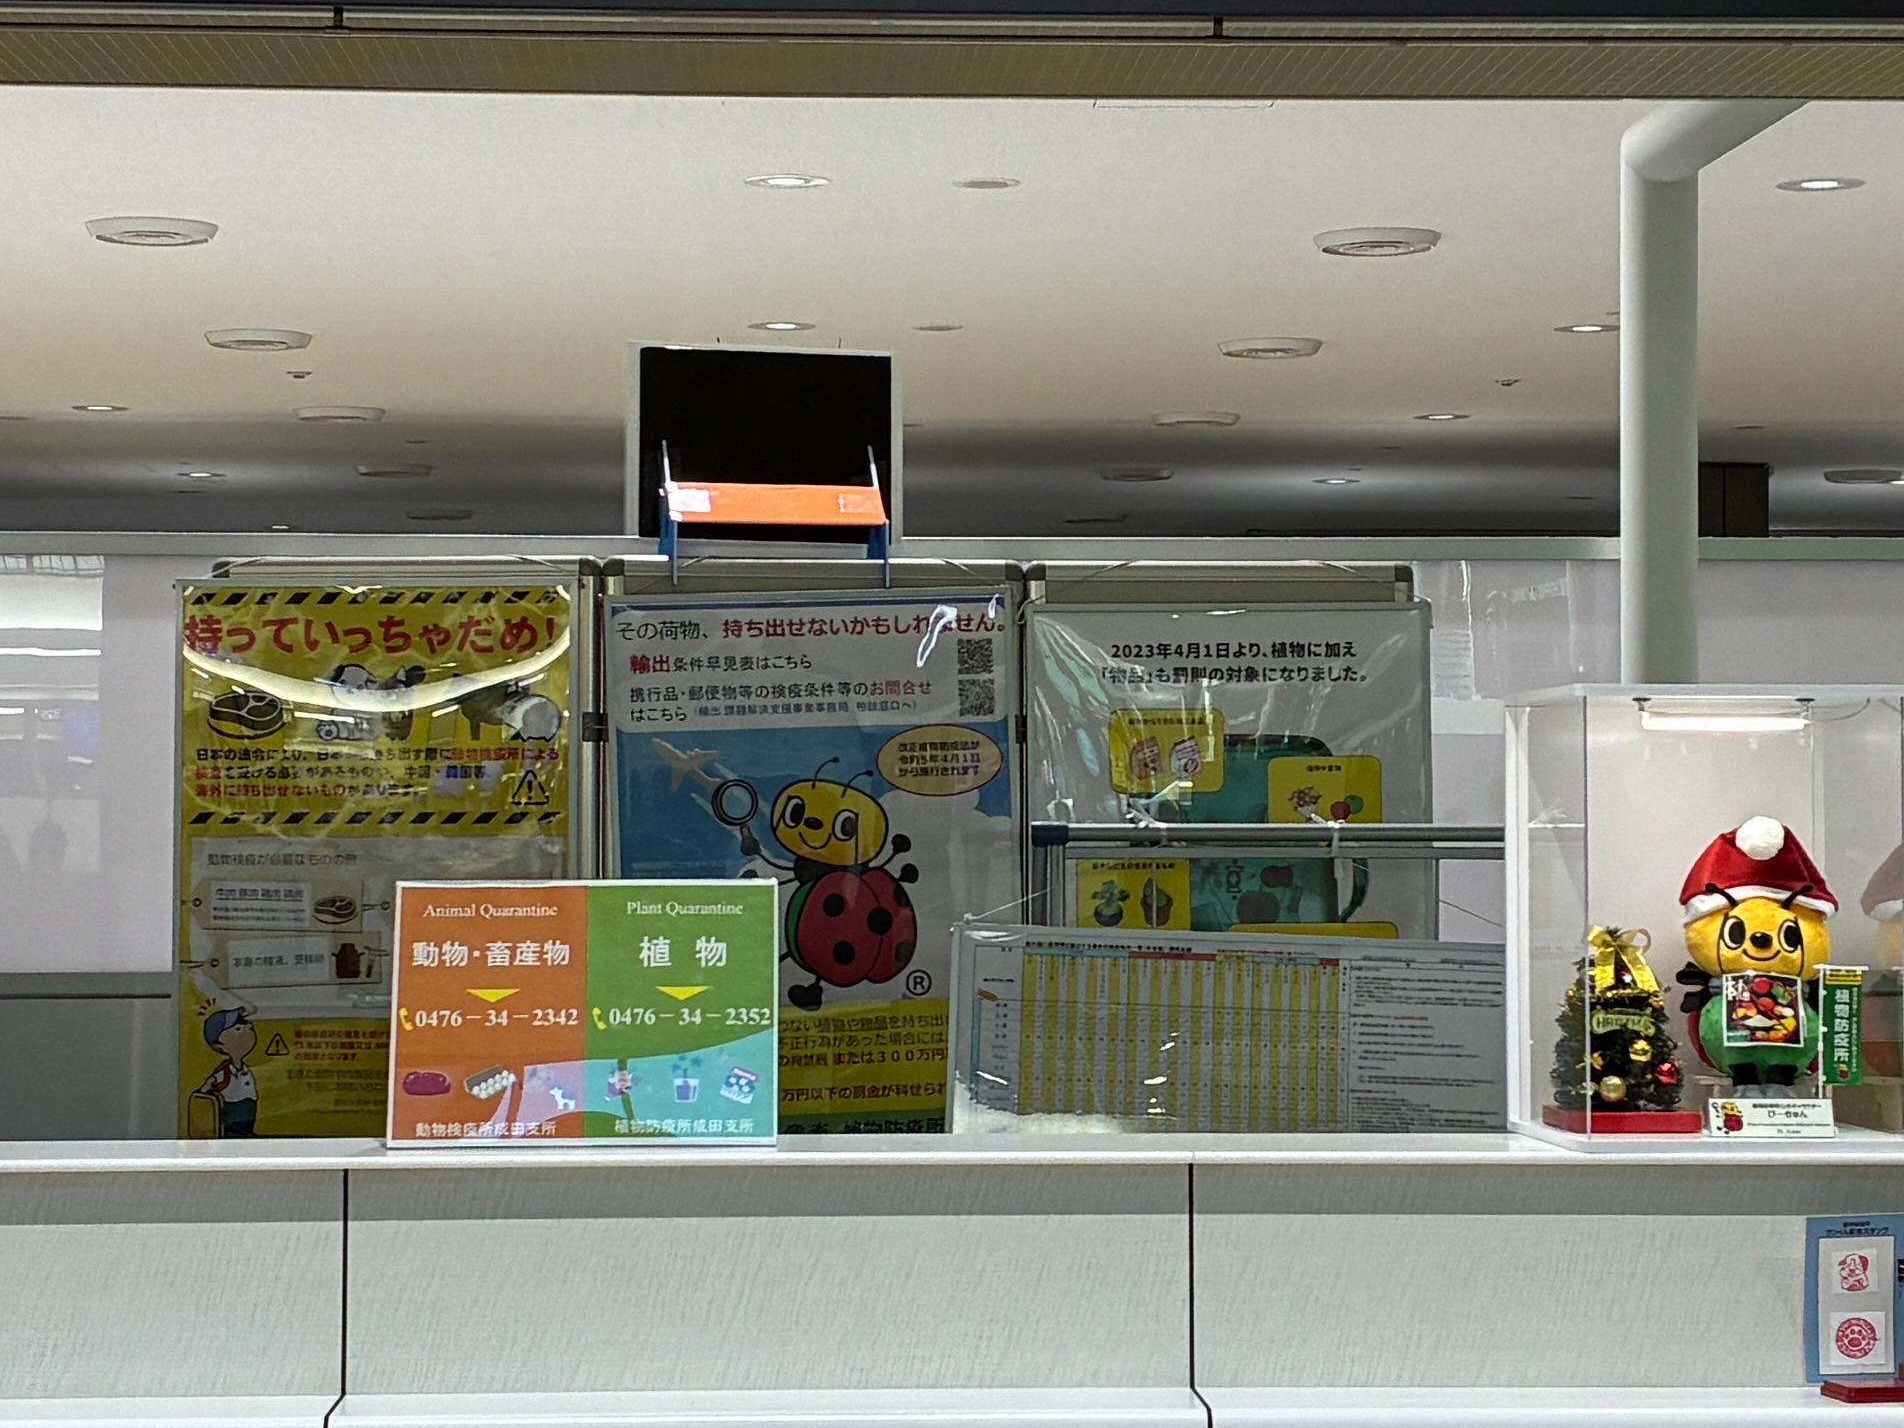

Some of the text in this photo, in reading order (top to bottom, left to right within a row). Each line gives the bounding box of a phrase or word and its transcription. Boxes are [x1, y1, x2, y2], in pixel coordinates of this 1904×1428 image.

[423, 903, 558, 920] Animal Quarantine
[627, 901, 743, 918] Plant Quarantine
[411, 940, 571, 968] 動物・畜産物
